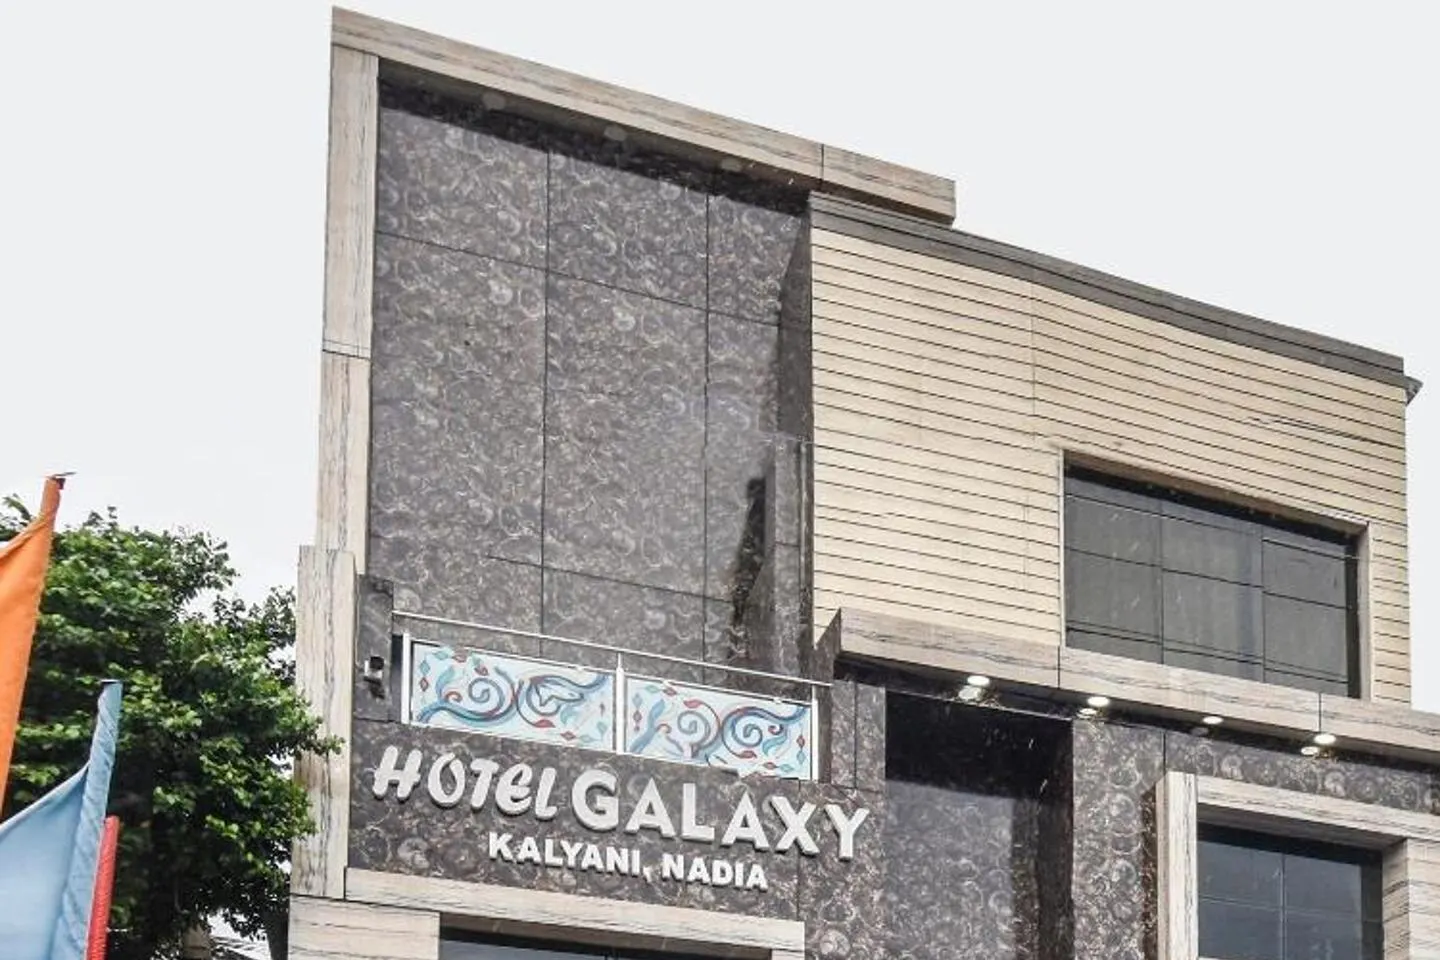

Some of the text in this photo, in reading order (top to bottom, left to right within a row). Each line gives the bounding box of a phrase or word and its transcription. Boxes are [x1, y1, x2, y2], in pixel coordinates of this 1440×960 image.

[571, 769, 870, 860] GALAXY
[488, 831, 769, 891] KALYANI, NADIA
